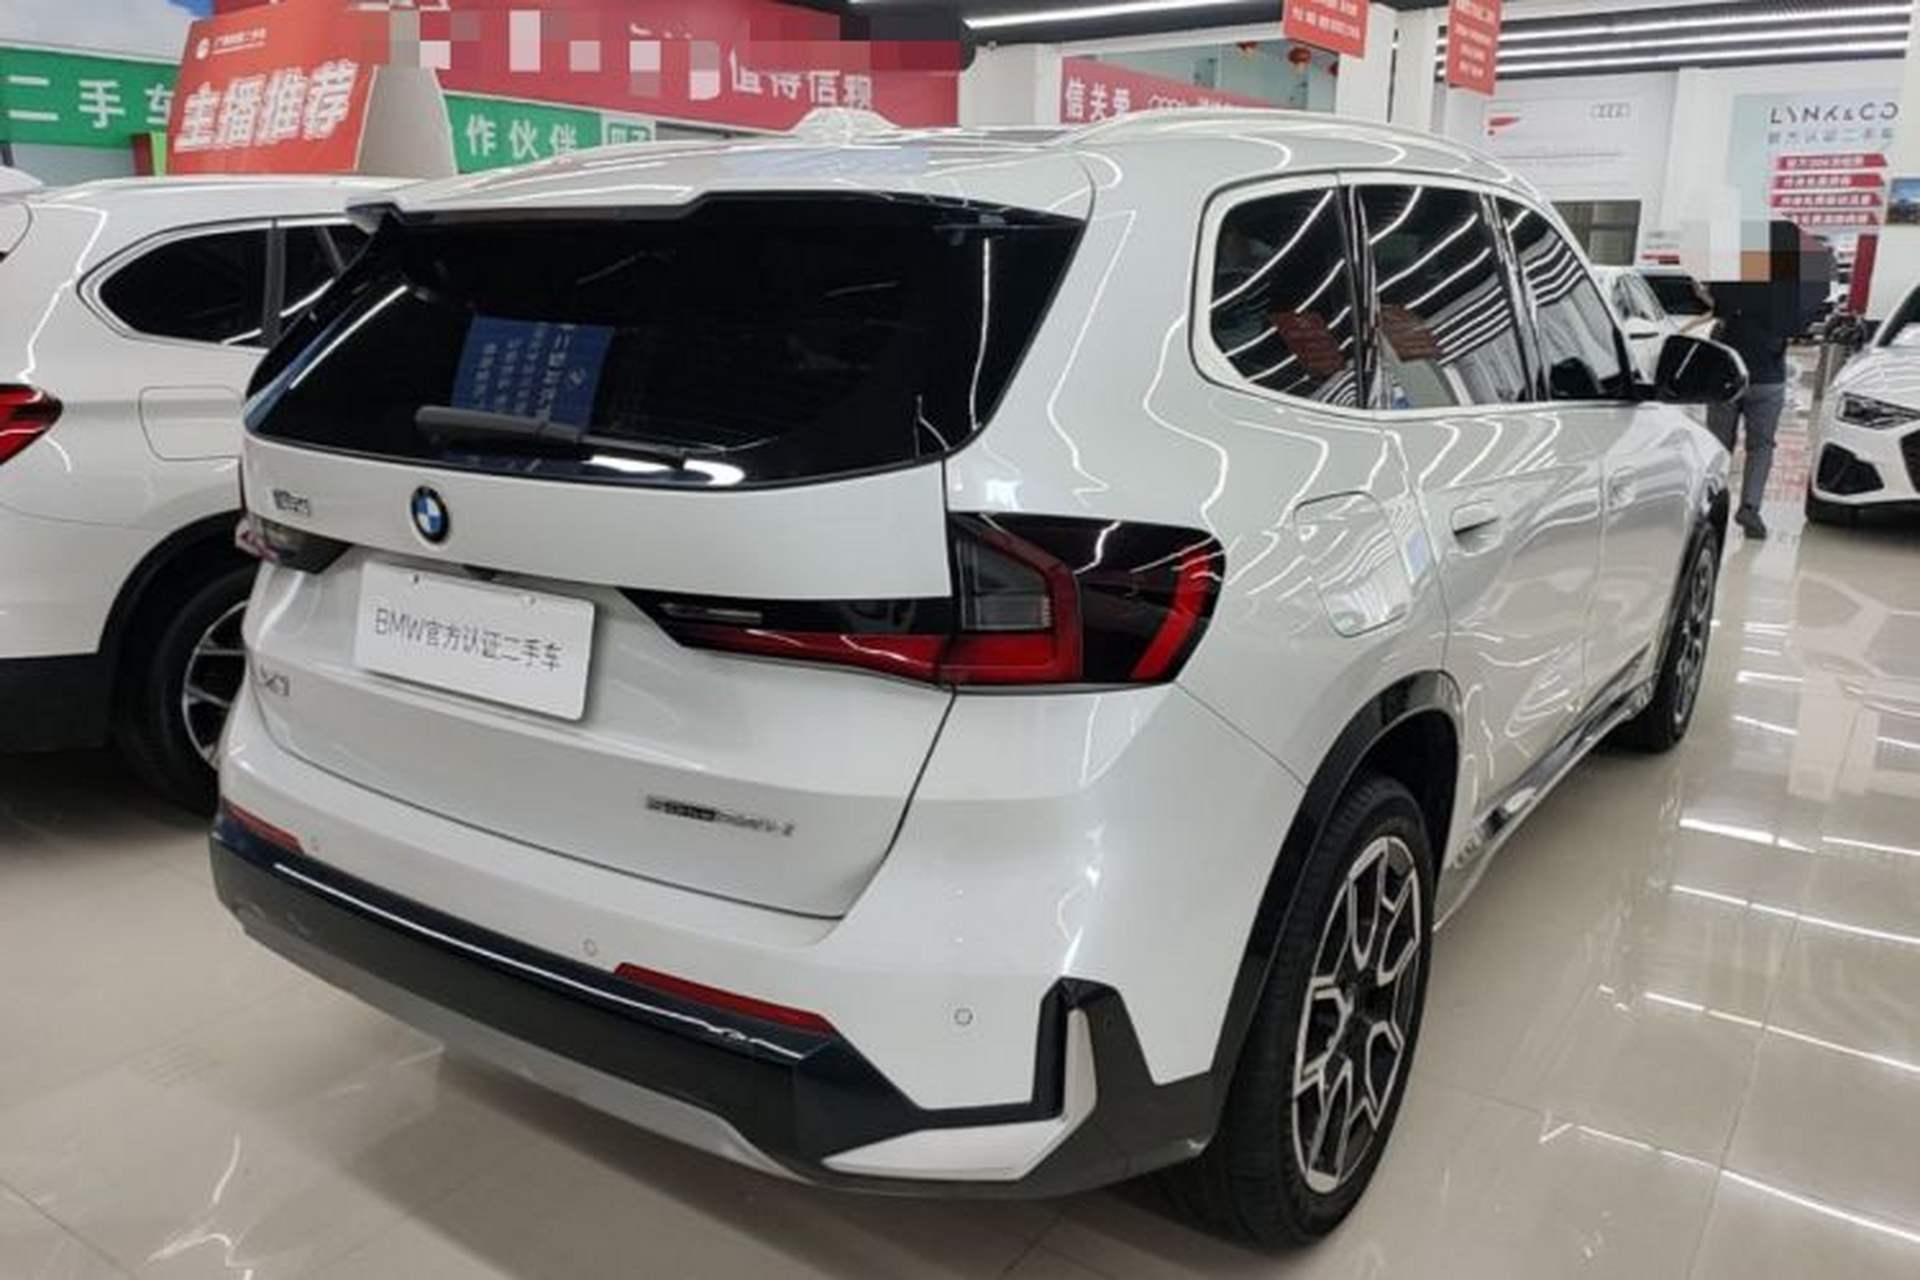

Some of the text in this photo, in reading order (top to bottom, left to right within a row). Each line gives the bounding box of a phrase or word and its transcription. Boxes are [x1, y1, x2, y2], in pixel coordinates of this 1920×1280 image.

[173, 58, 360, 153] 主播推荐
[466, 113, 577, 158] 作伙伴
[375, 607, 562, 670] BMW官方认证二手车
